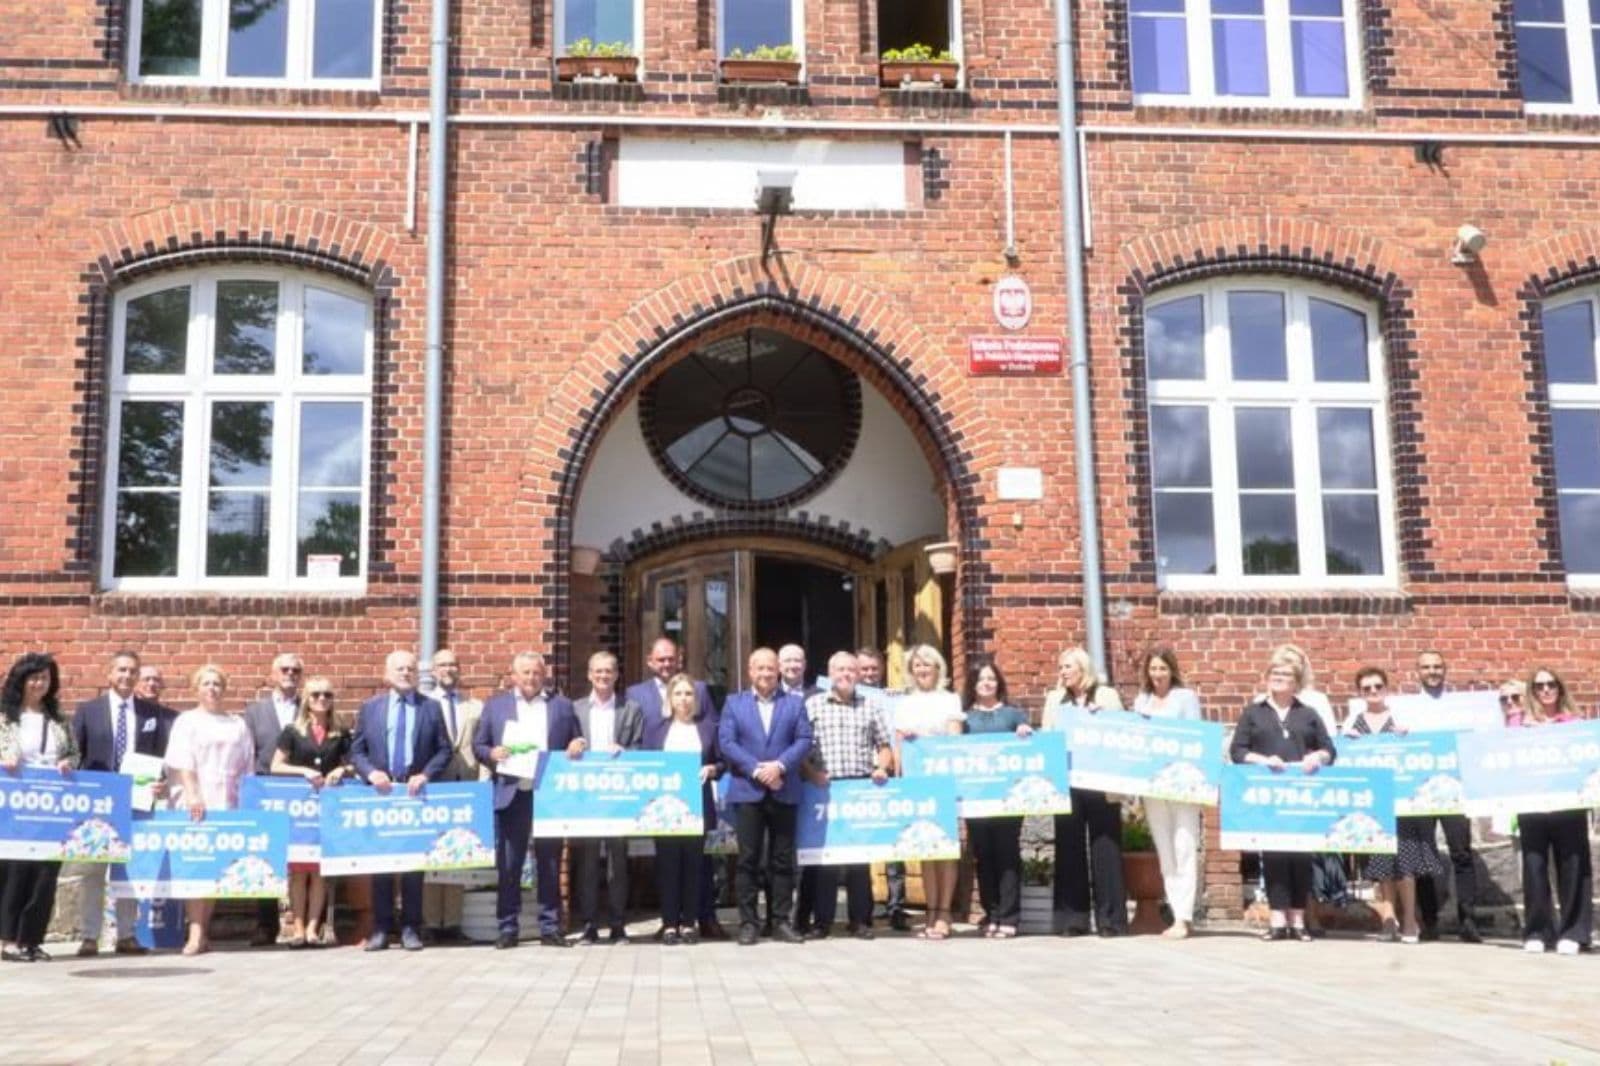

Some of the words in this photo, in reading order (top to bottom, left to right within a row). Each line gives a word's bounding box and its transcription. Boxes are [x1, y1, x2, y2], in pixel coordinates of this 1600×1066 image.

[582, 773, 660, 793] 000,00
[370, 806, 450, 827] 000,00
[452, 805, 473, 824] zł
[165, 832, 246, 853] 000,00
[248, 832, 269, 852] zł
